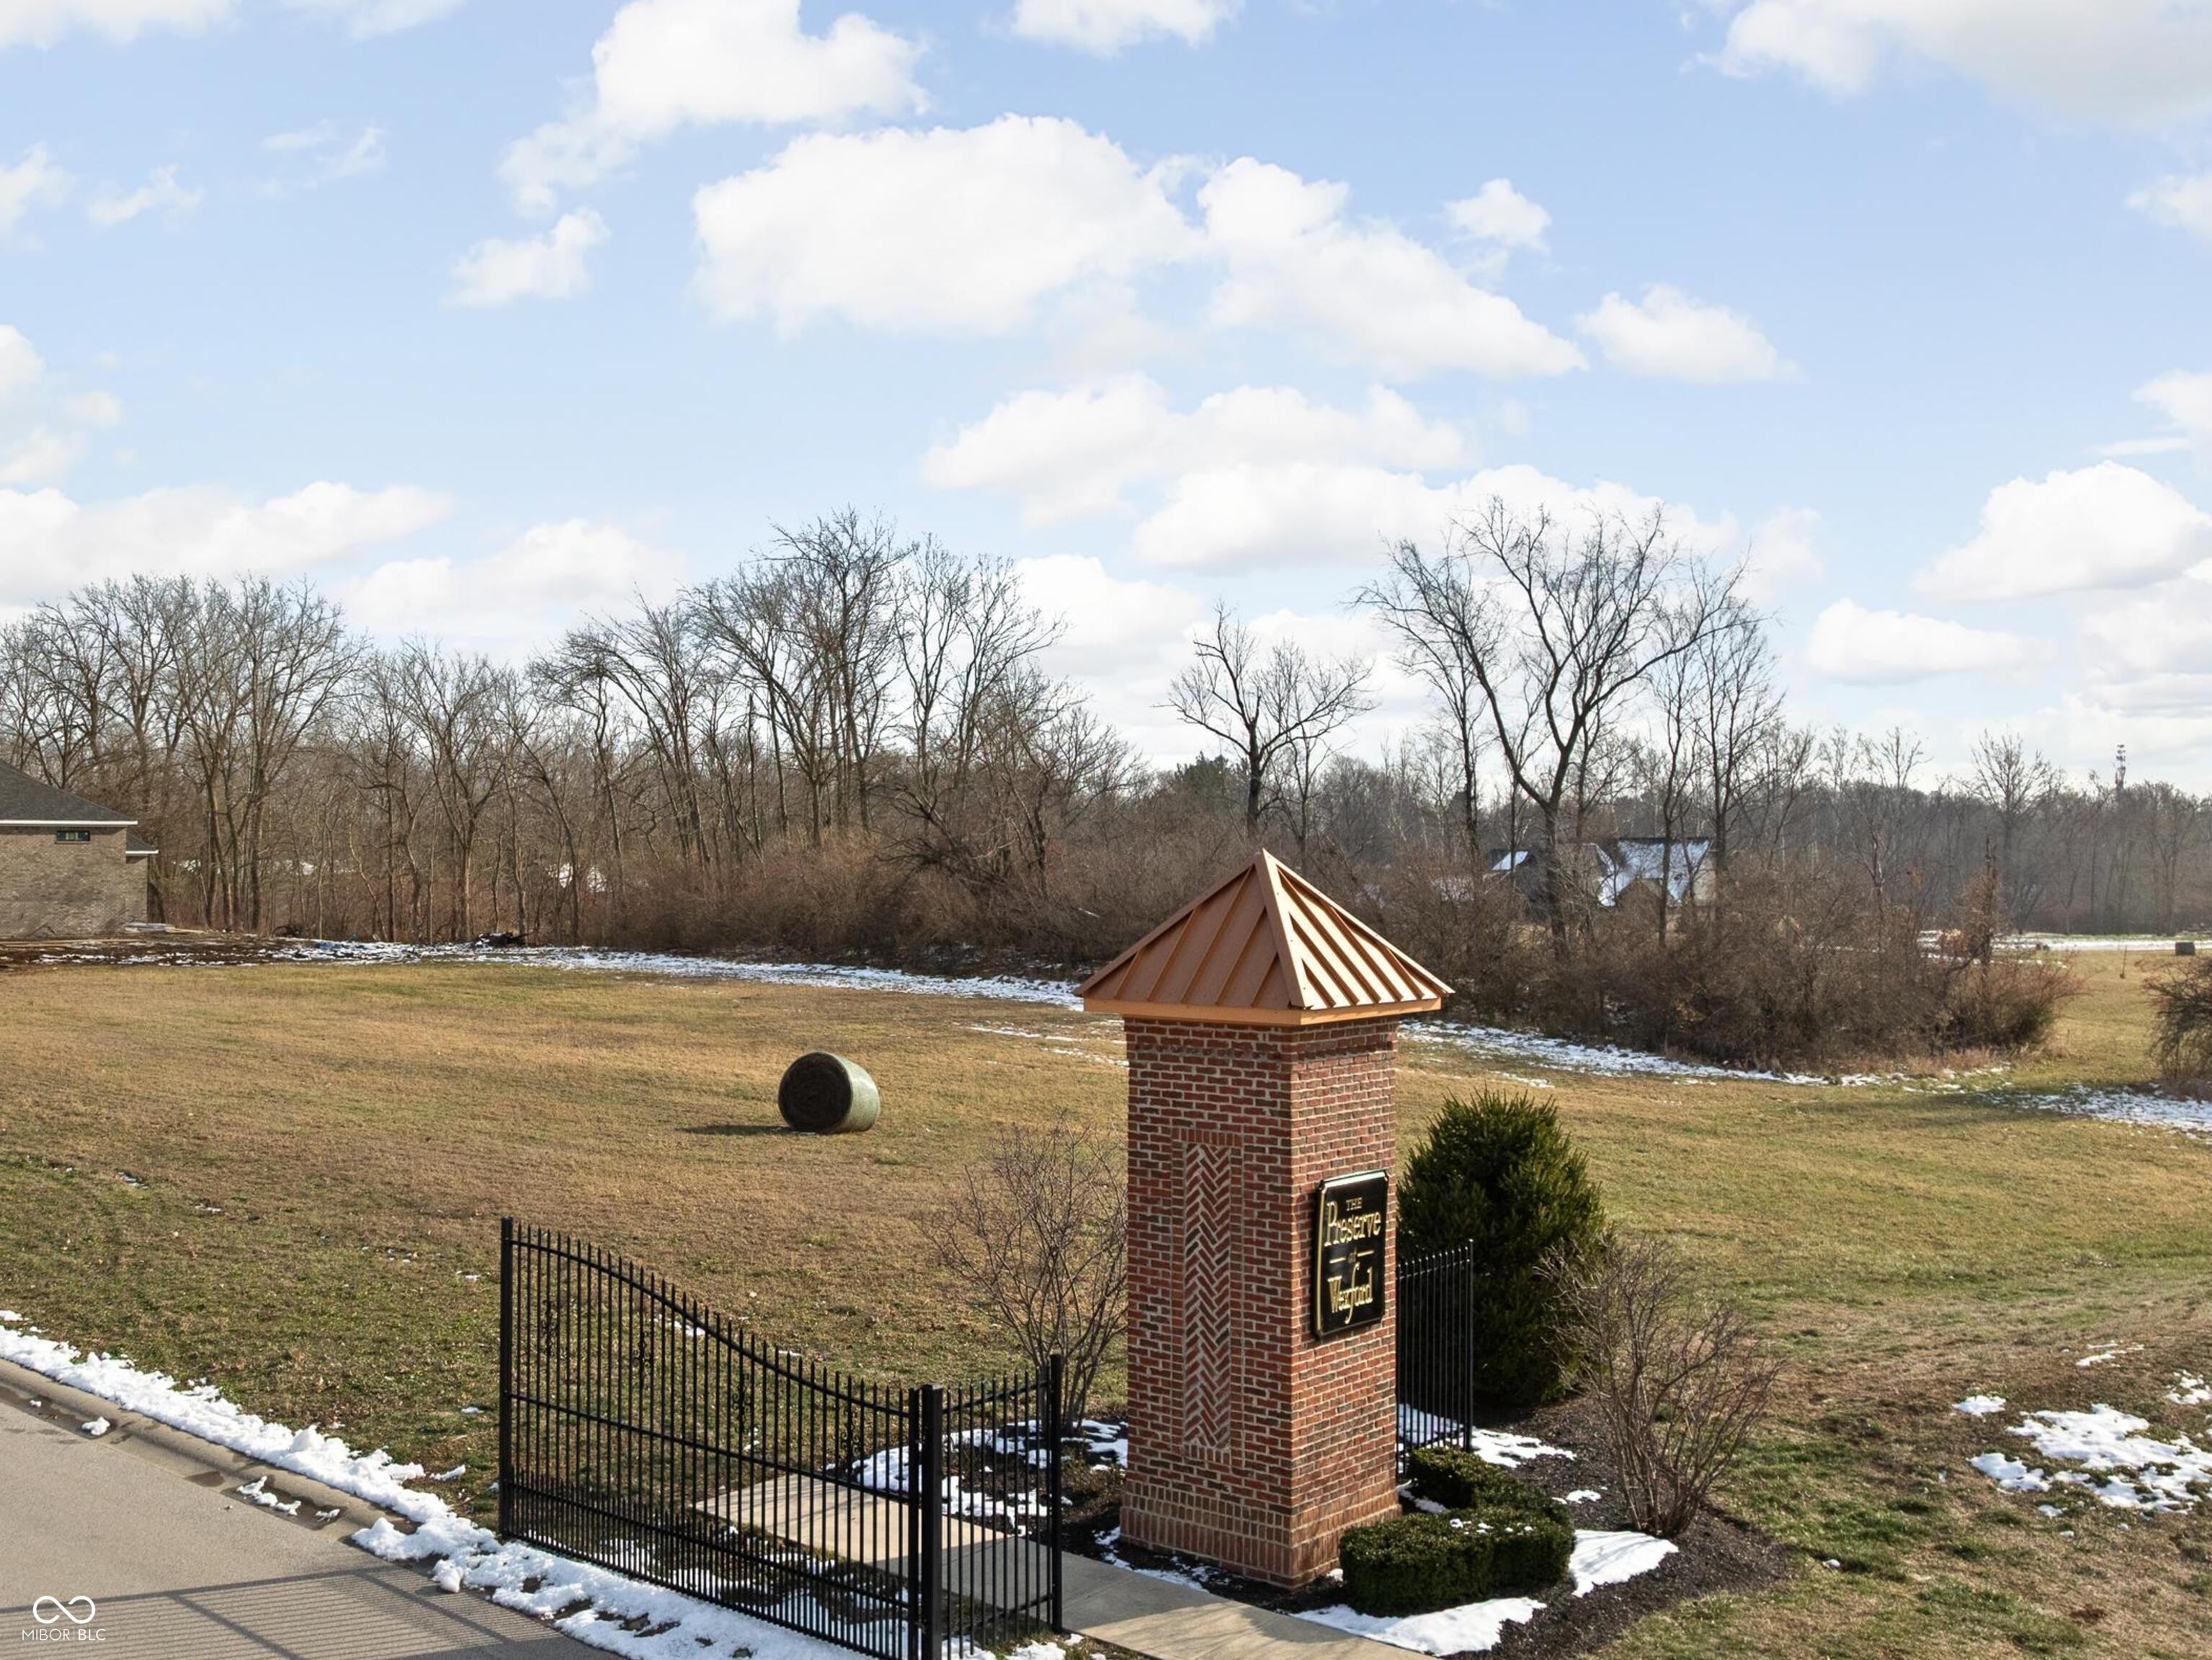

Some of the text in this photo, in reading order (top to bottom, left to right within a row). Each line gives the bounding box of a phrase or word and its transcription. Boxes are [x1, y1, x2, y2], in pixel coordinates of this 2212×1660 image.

[1346, 1197, 1363, 1211] THE
[1324, 1201, 1381, 1246] Preserve
[1348, 1248, 1357, 1263] at
[1327, 1262, 1373, 1324] Wexford
